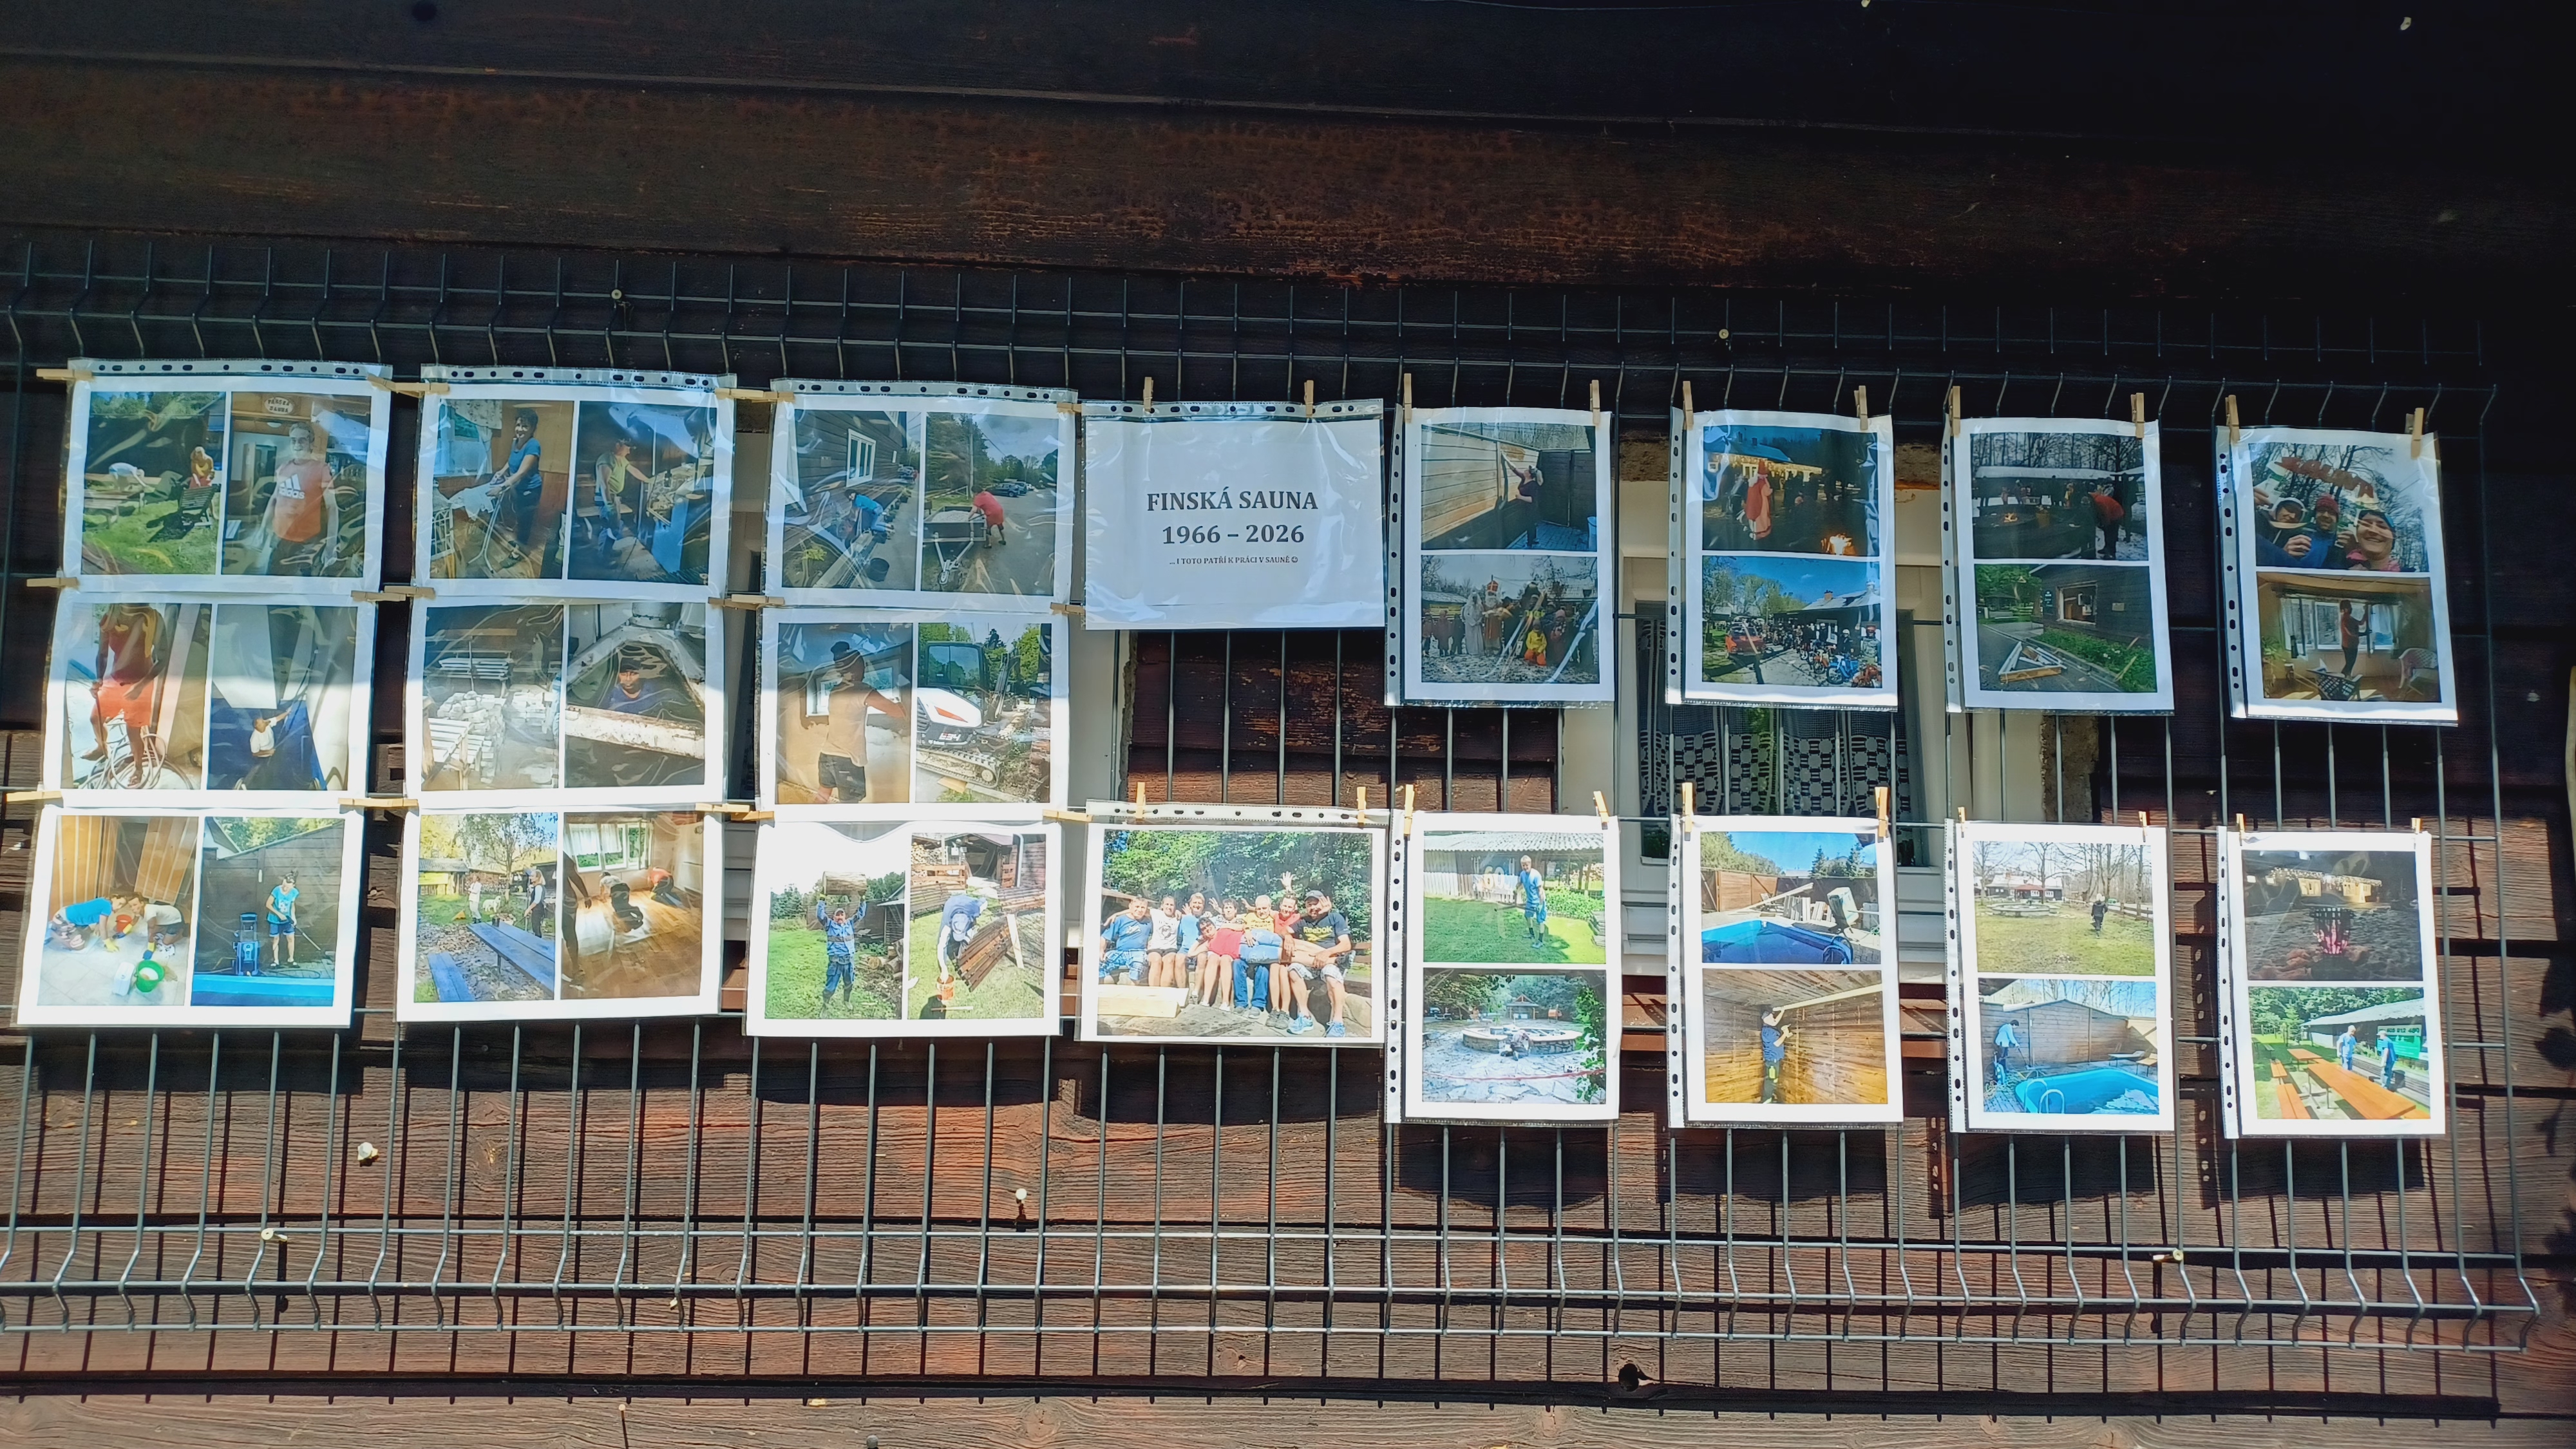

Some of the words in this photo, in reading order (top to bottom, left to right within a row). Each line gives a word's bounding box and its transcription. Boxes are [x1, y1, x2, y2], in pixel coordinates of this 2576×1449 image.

[1147, 486, 1233, 511] FINSKÁ
[1239, 491, 1318, 509] SAUNA
[1162, 525, 1221, 544] 1966
[1245, 524, 1305, 543] 2026
[1204, 555, 1227, 564] PATŘÍ
[1235, 555, 1257, 564] PRÁCI
